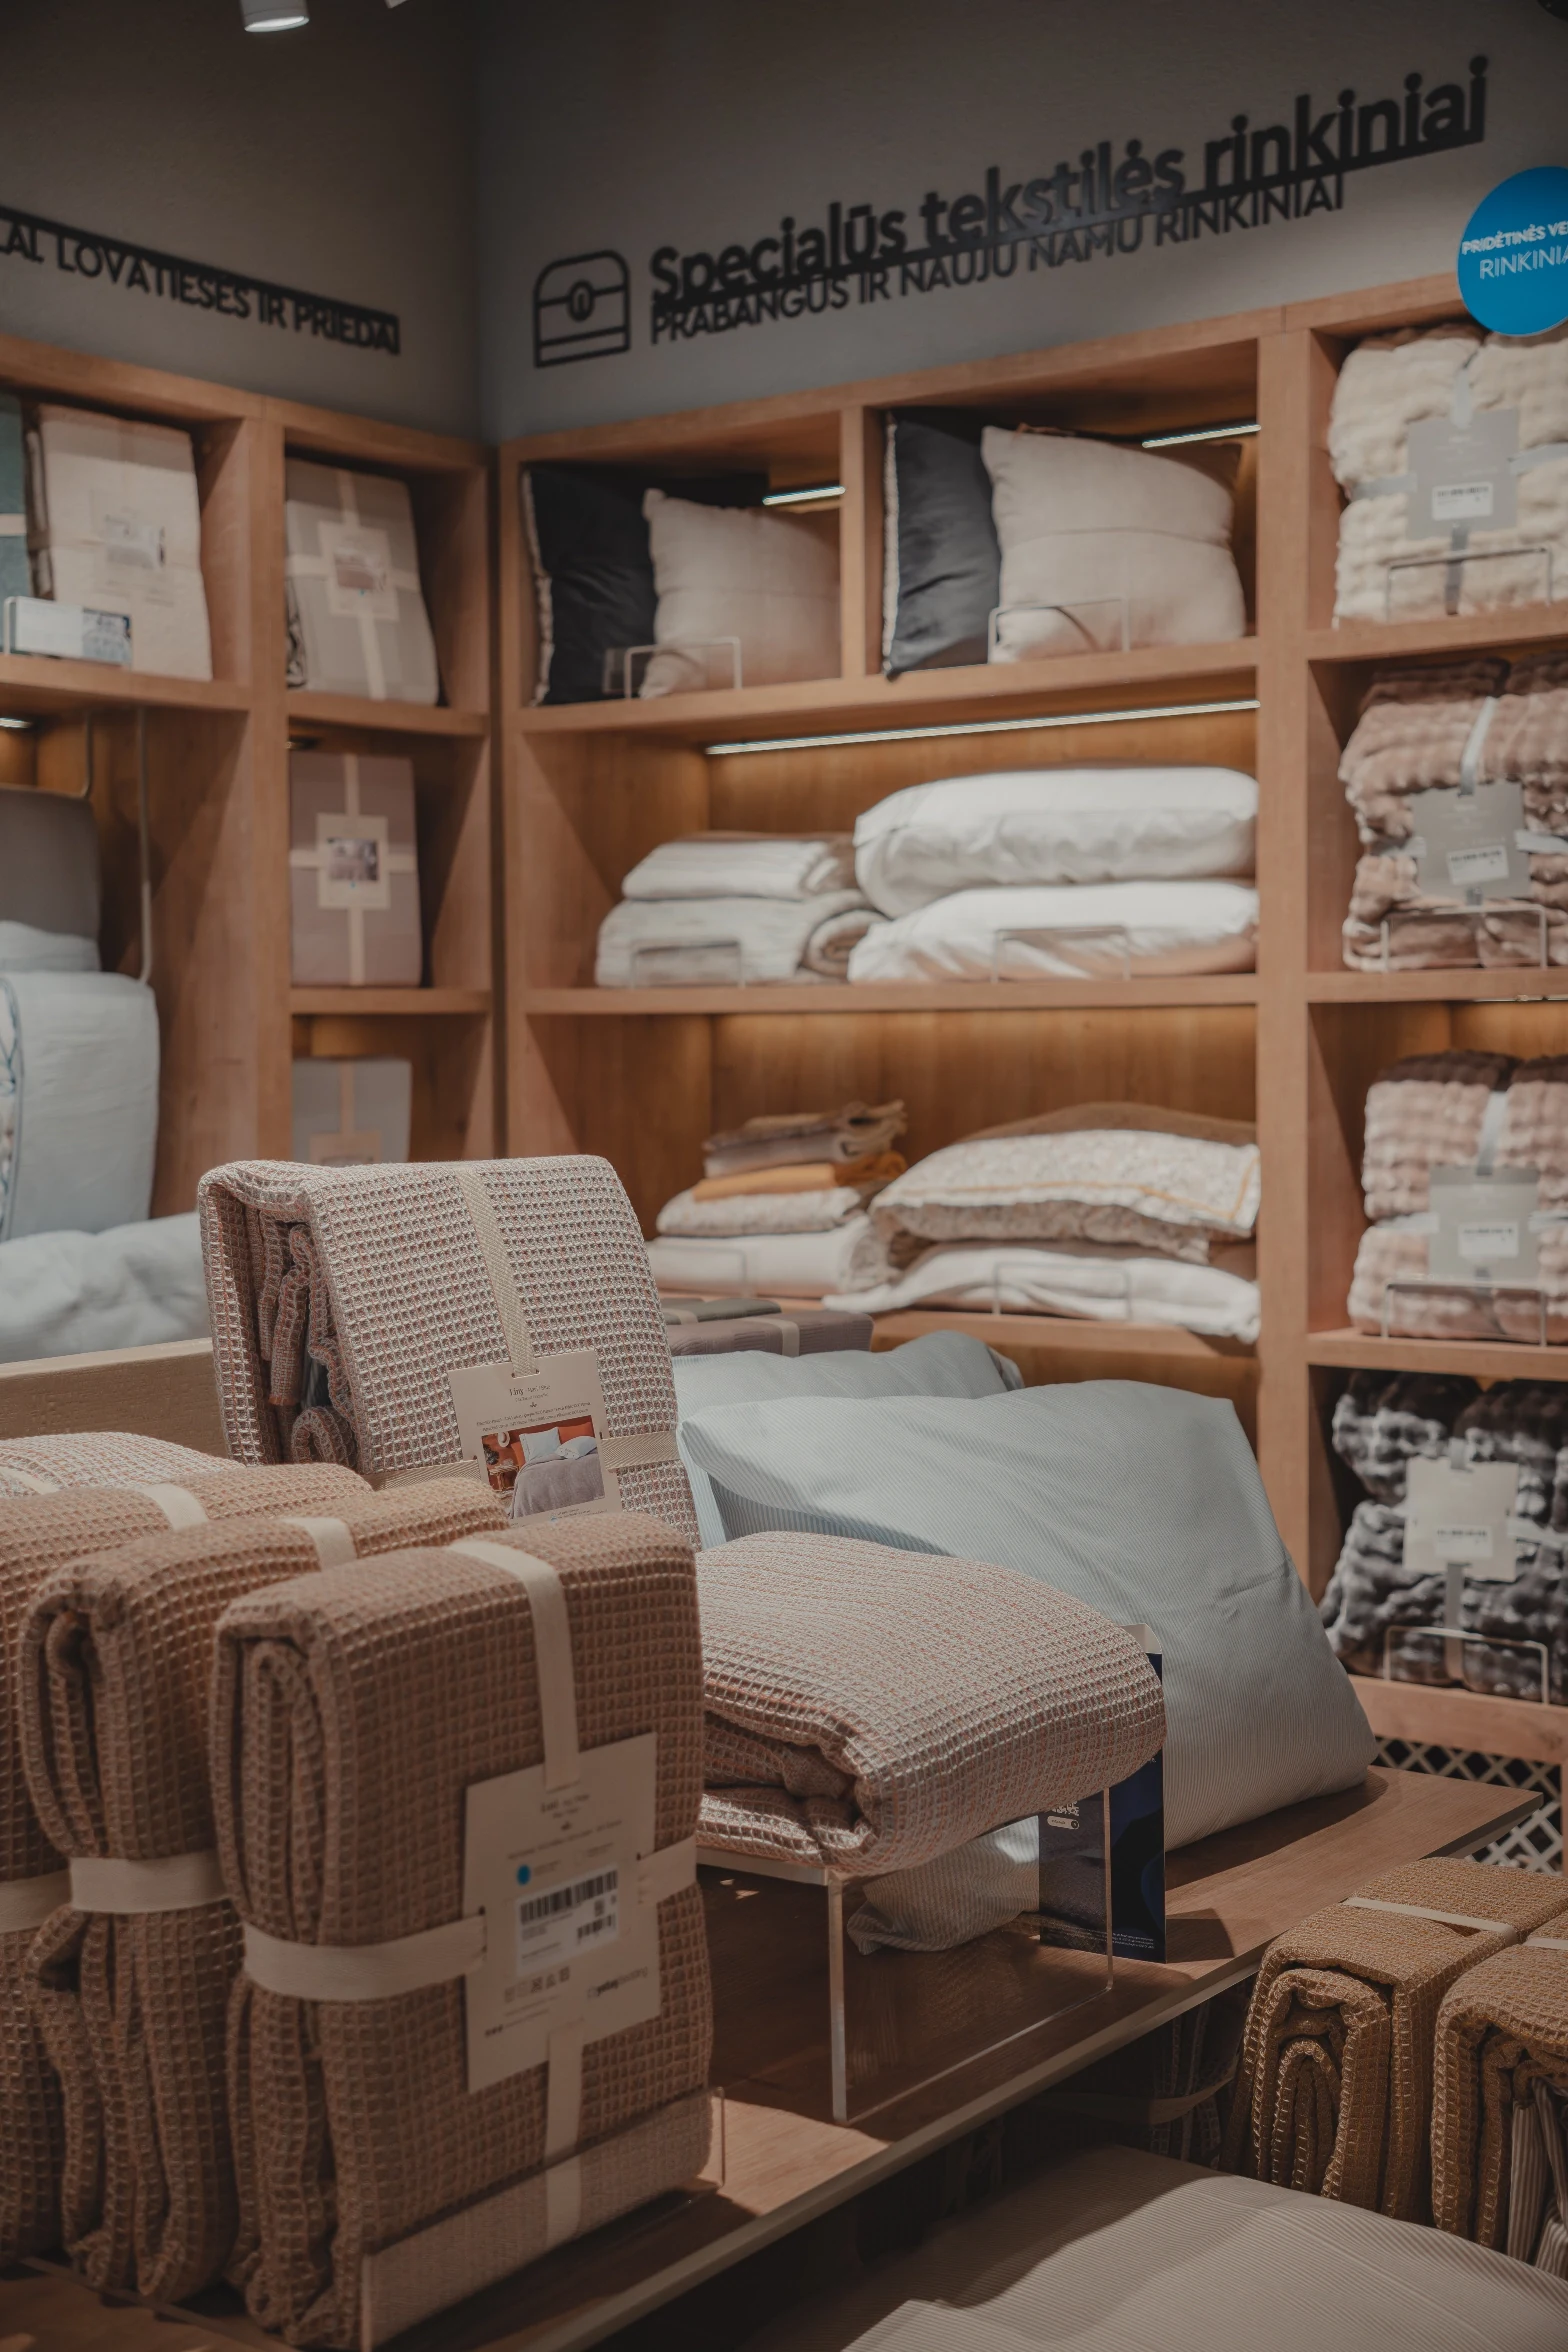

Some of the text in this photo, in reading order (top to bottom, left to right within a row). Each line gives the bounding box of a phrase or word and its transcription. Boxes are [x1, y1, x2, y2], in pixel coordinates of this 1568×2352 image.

[651, 56, 1487, 305] Specialūs tekstilės rinkiniai
[652, 275, 848, 345] PRABANGUS
[859, 267, 889, 304] IR
[1156, 171, 1342, 247] RINKINIAI
[1461, 220, 1568, 255] PRIDĖTINĖS VE
[257, 288, 286, 329] IR
